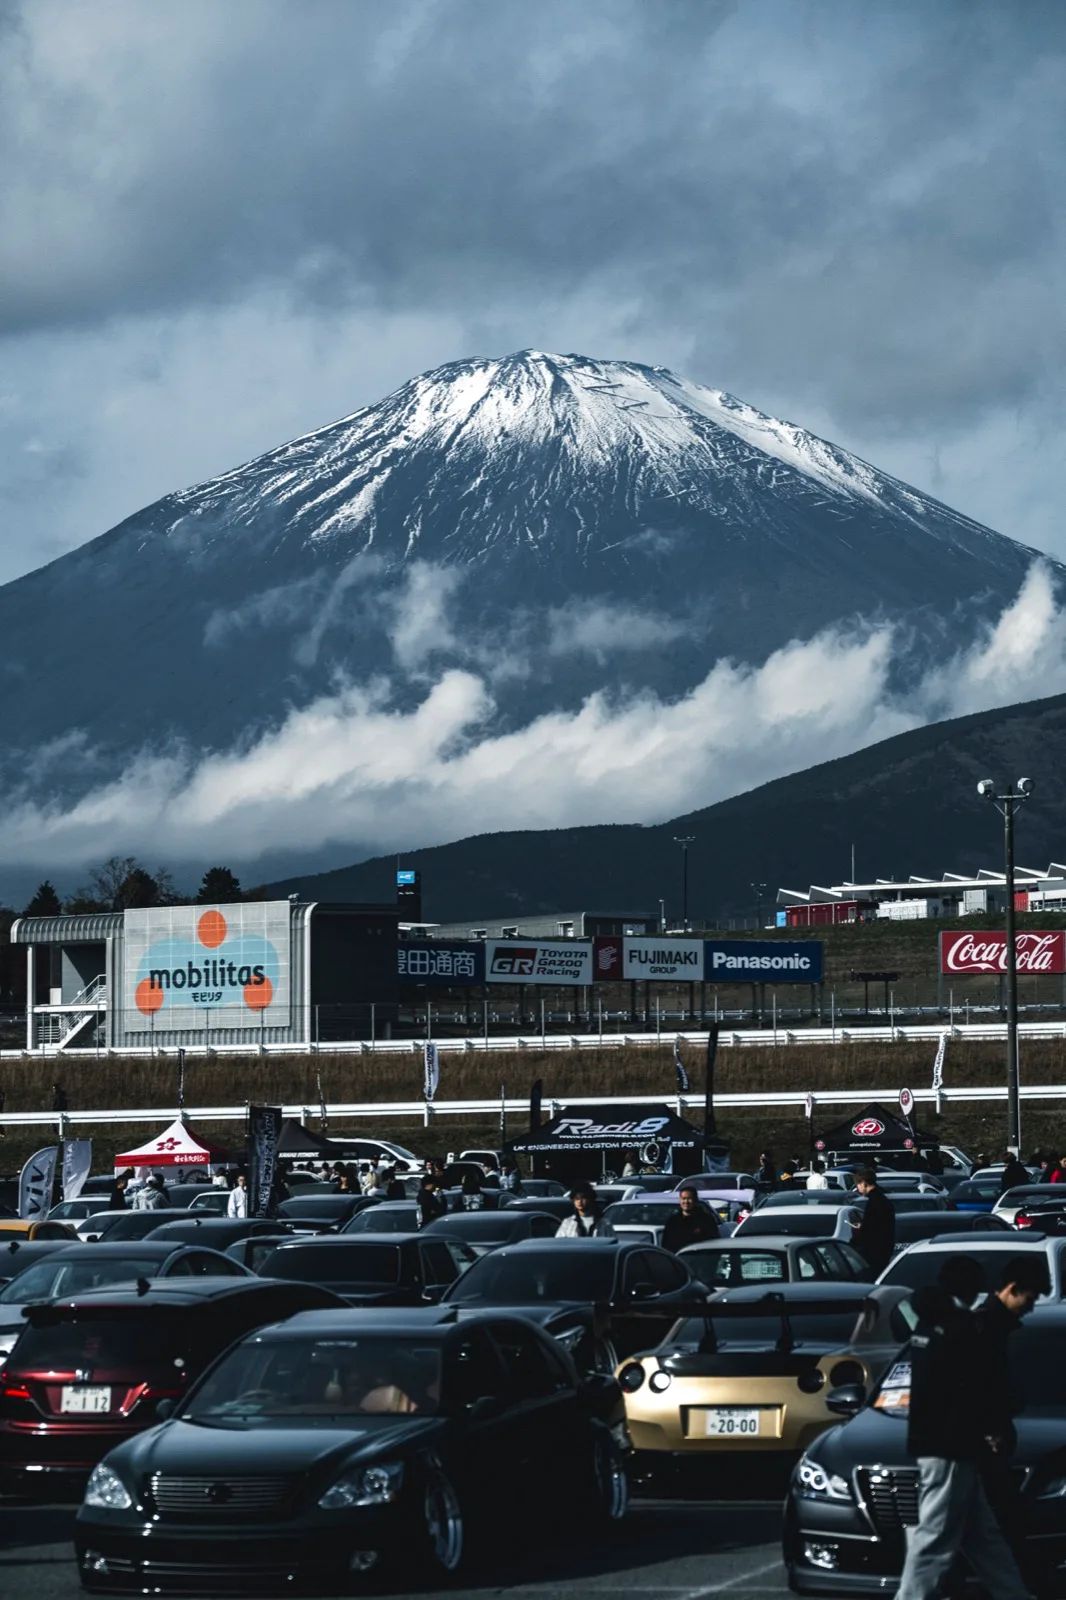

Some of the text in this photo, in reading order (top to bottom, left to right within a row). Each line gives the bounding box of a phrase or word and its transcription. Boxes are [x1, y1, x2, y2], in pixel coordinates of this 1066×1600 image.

[540, 949, 588, 959] TOYOTA
[628, 950, 699, 965] FUJIMAKI
[492, 957, 533, 974] GR
[538, 958, 583, 968] GAZOO
[712, 952, 811, 970] Panasonic
[149, 959, 265, 989] mobilitas
[536, 967, 581, 979] Racing
[650, 966, 677, 975] GROUP
[191, 991, 223, 1003] モビリタ
[552, 1117, 670, 1134] Radi8
[527, 1142, 581, 1151] ENGINEERED
[583, 1141, 620, 1150] CUSTOM
[718, 1419, 757, 1434] 20-00
